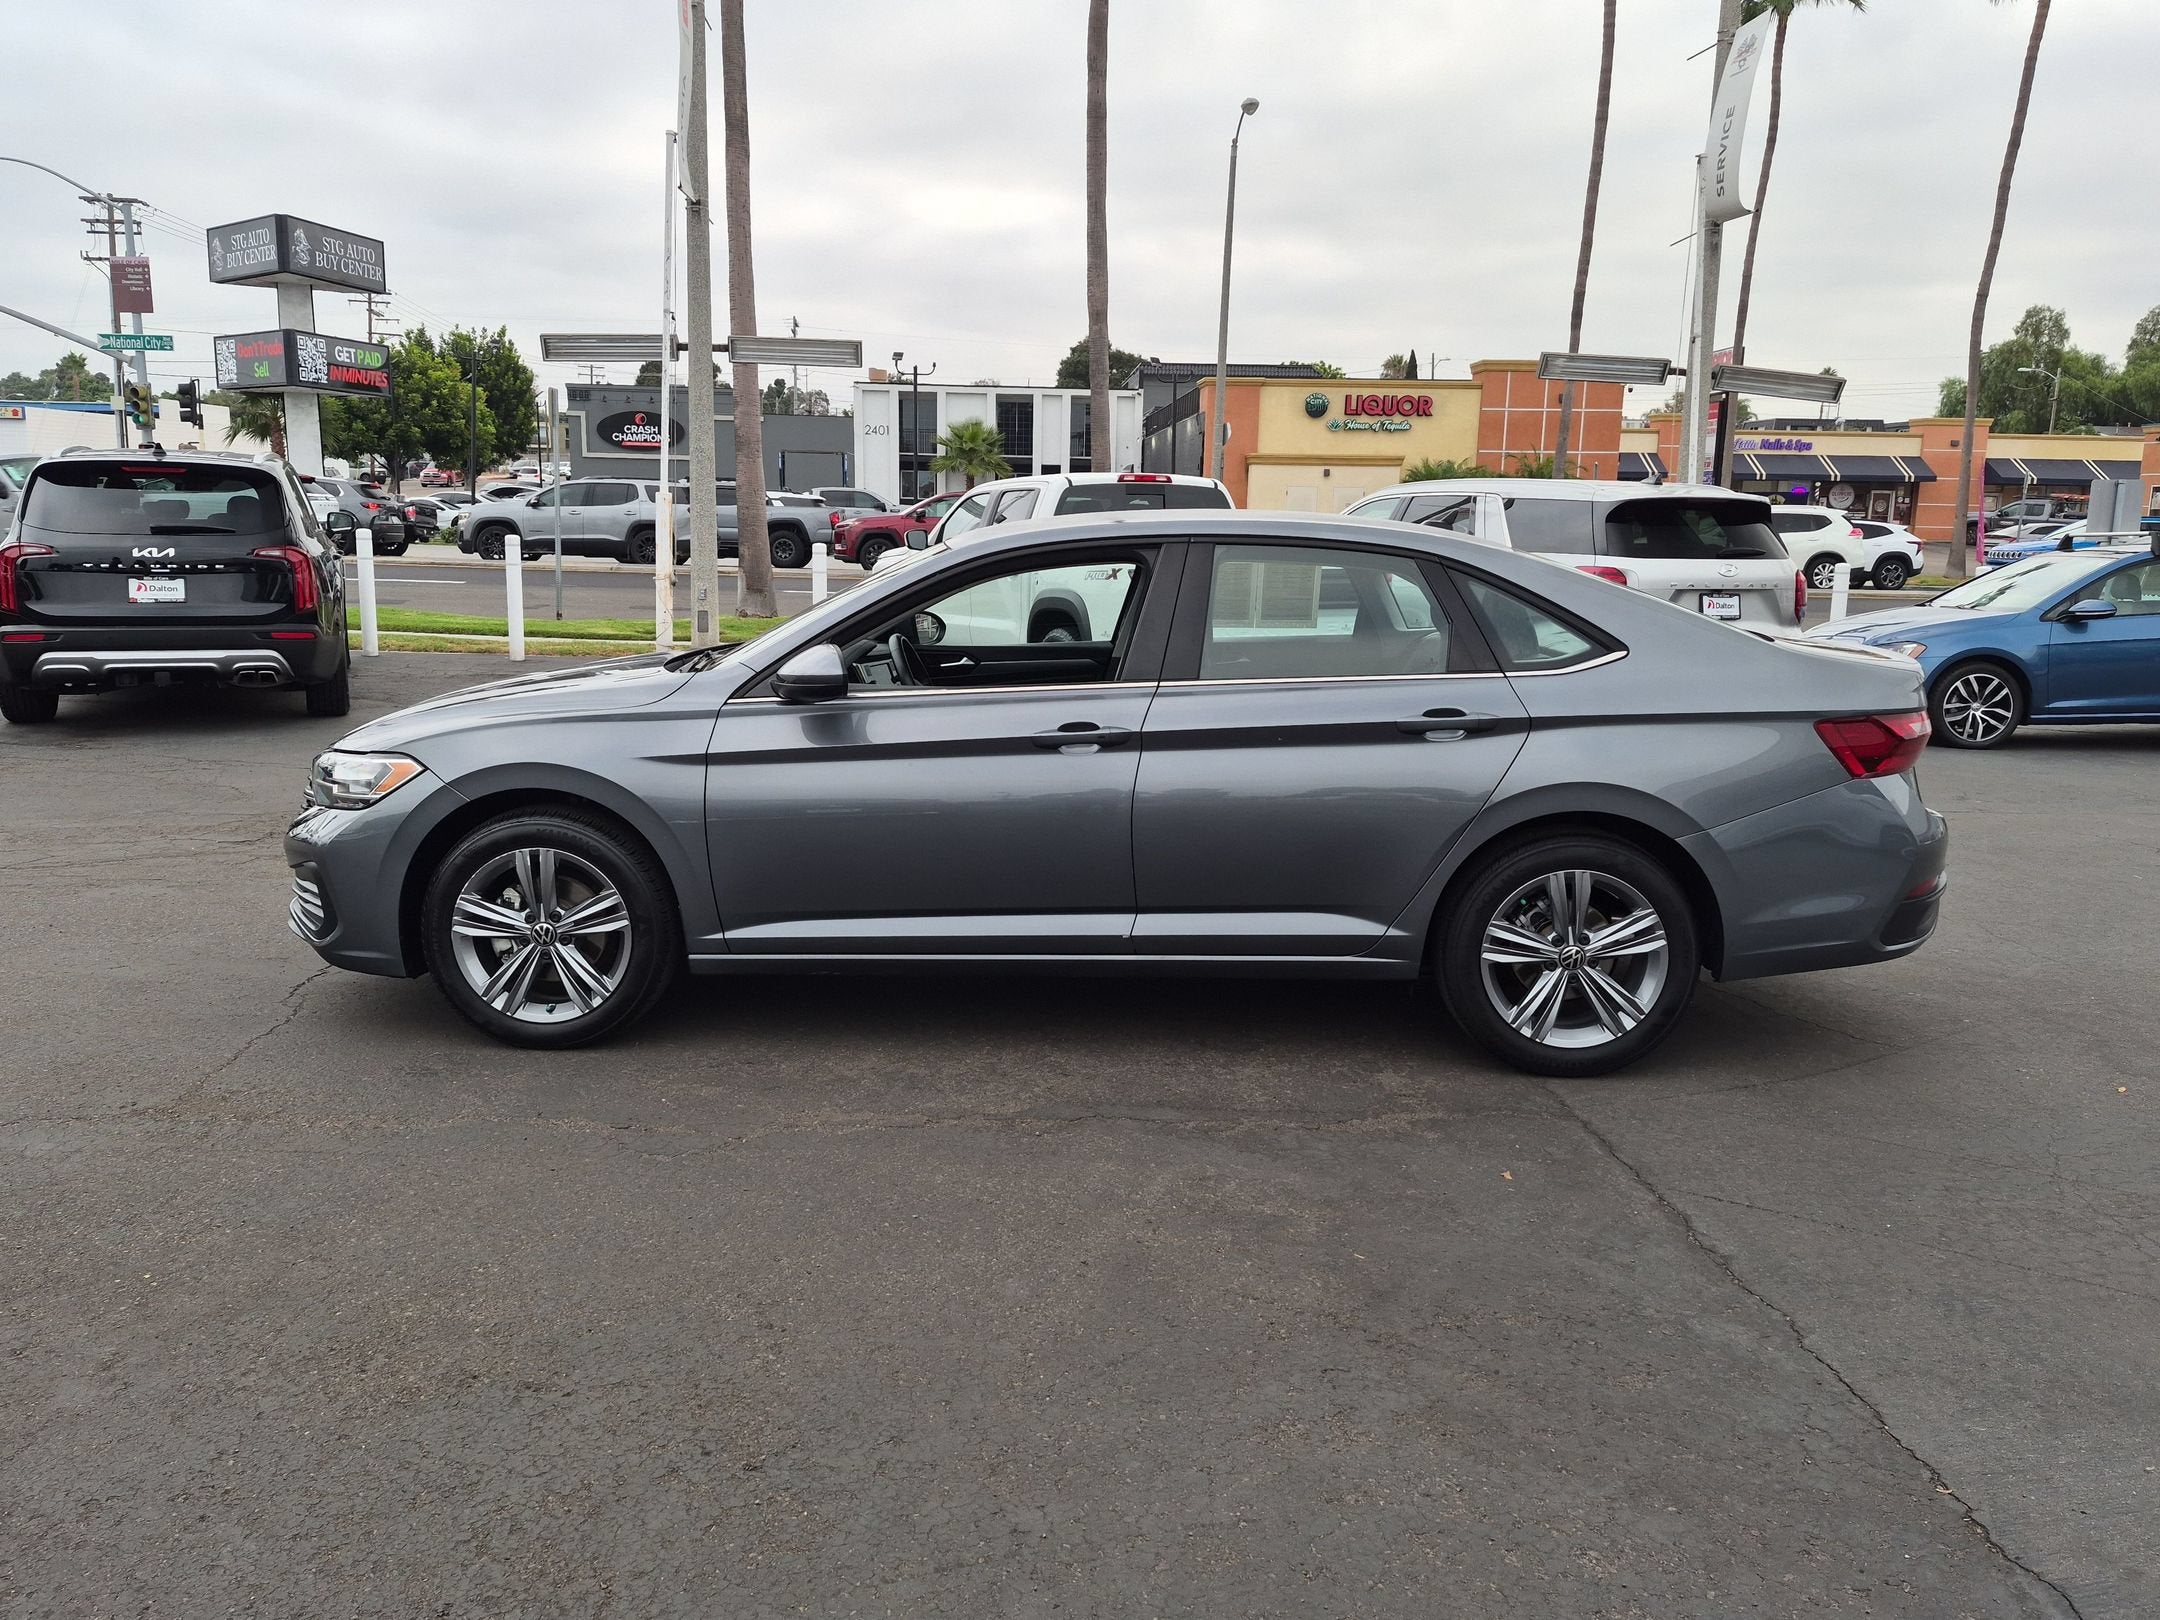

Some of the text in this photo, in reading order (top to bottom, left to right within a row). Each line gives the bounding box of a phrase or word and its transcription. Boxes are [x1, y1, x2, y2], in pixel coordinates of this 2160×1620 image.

[1716, 104, 1736, 198] SERVICE
[231, 227, 270, 251] STG AUTO
[227, 244, 277, 269] BUY CENTER
[322, 236, 375, 263] STG AUTO
[315, 251, 383, 282] BUY CENTER
[110, 336, 144, 349] National
[145, 336, 162, 349] City
[334, 345, 382, 367] GET PAID
[254, 361, 270, 378] Sell
[1344, 394, 1433, 417] LIQUOR
[623, 425, 658, 434] CRASH
[864, 424, 890, 436] 2401
[1344, 419, 1411, 432] House of Tequila
[1760, 439, 1785, 450] Nails
[1793, 438, 1812, 452] Spa
[132, 547, 175, 558] KIA
[149, 584, 178, 592] Dalton
[1715, 602, 1736, 610] Dalton
